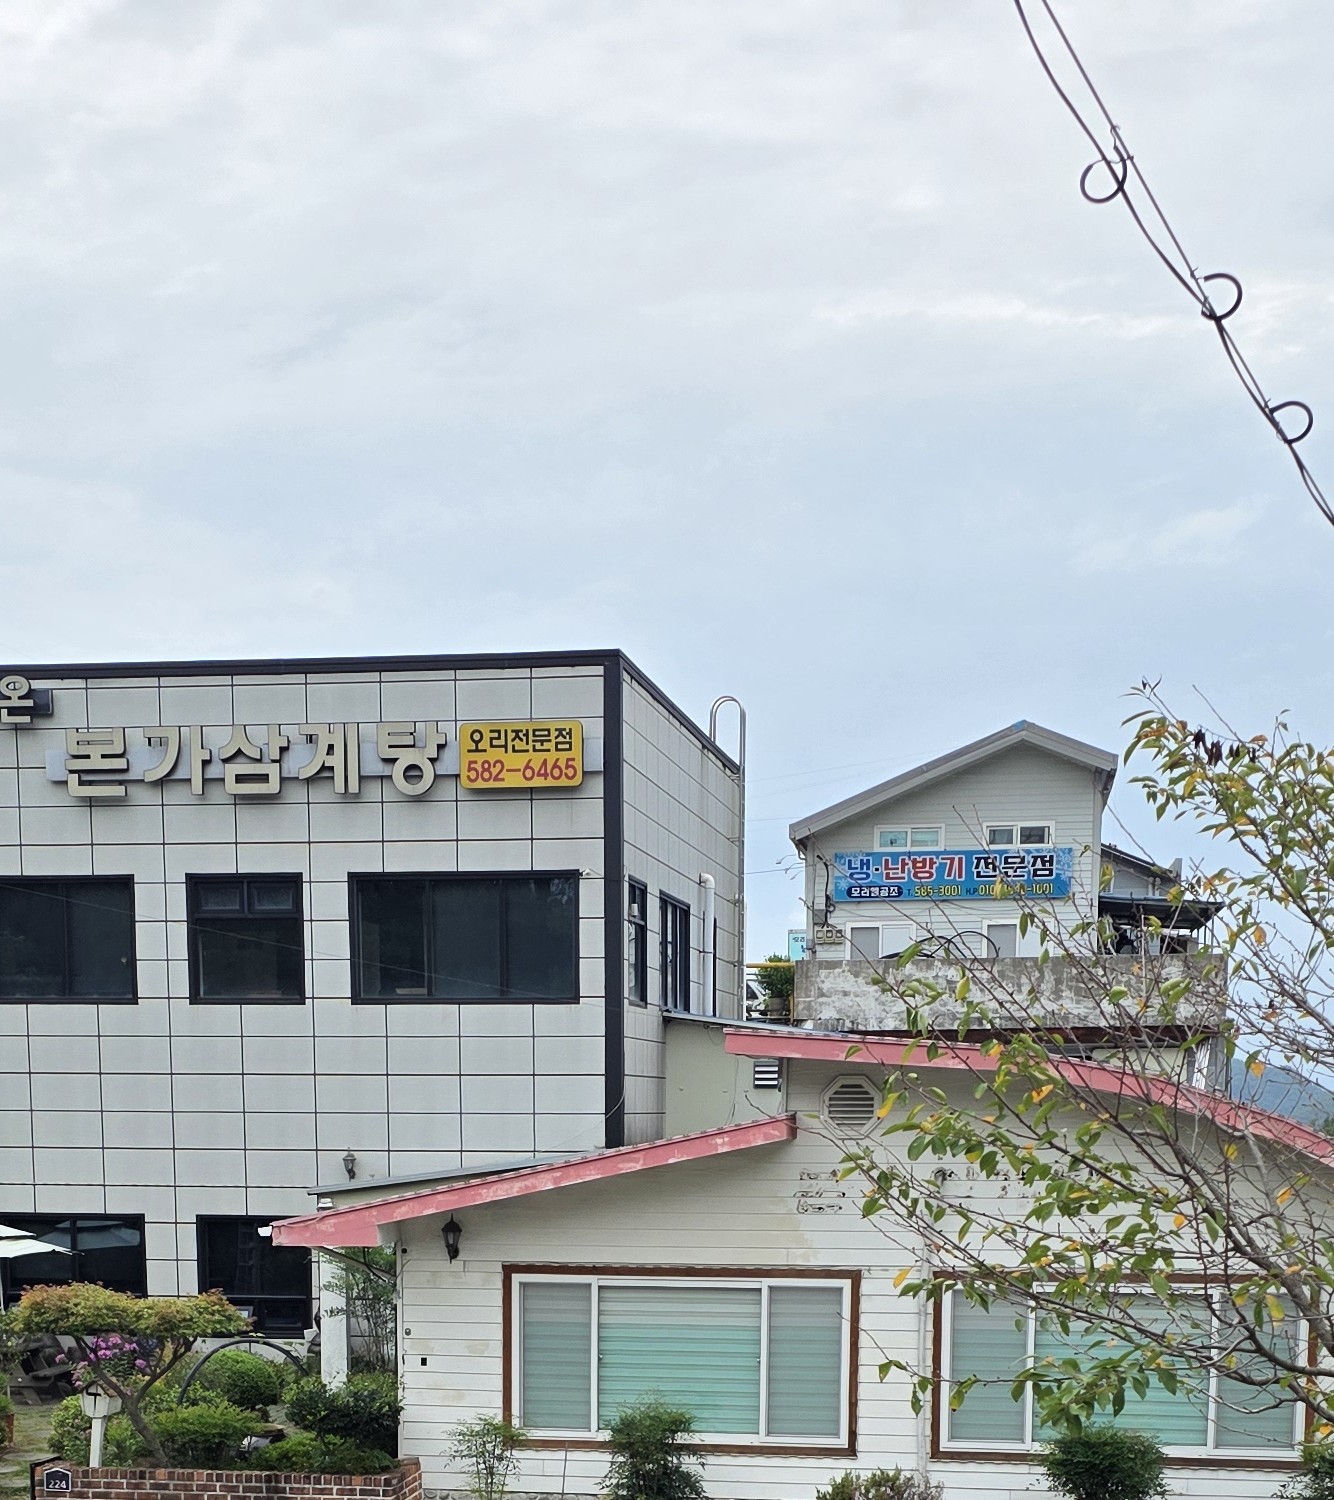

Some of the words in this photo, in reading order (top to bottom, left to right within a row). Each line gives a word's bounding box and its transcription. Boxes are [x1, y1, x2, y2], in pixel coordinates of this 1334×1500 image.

[466, 727, 573, 754] 오리전문점
[64, 722, 446, 797] 본가삼계탕
[465, 757, 578, 783] 582-6465
[973, 853, 1055, 879] 전문점
[48, 1480, 67, 1489] 224
